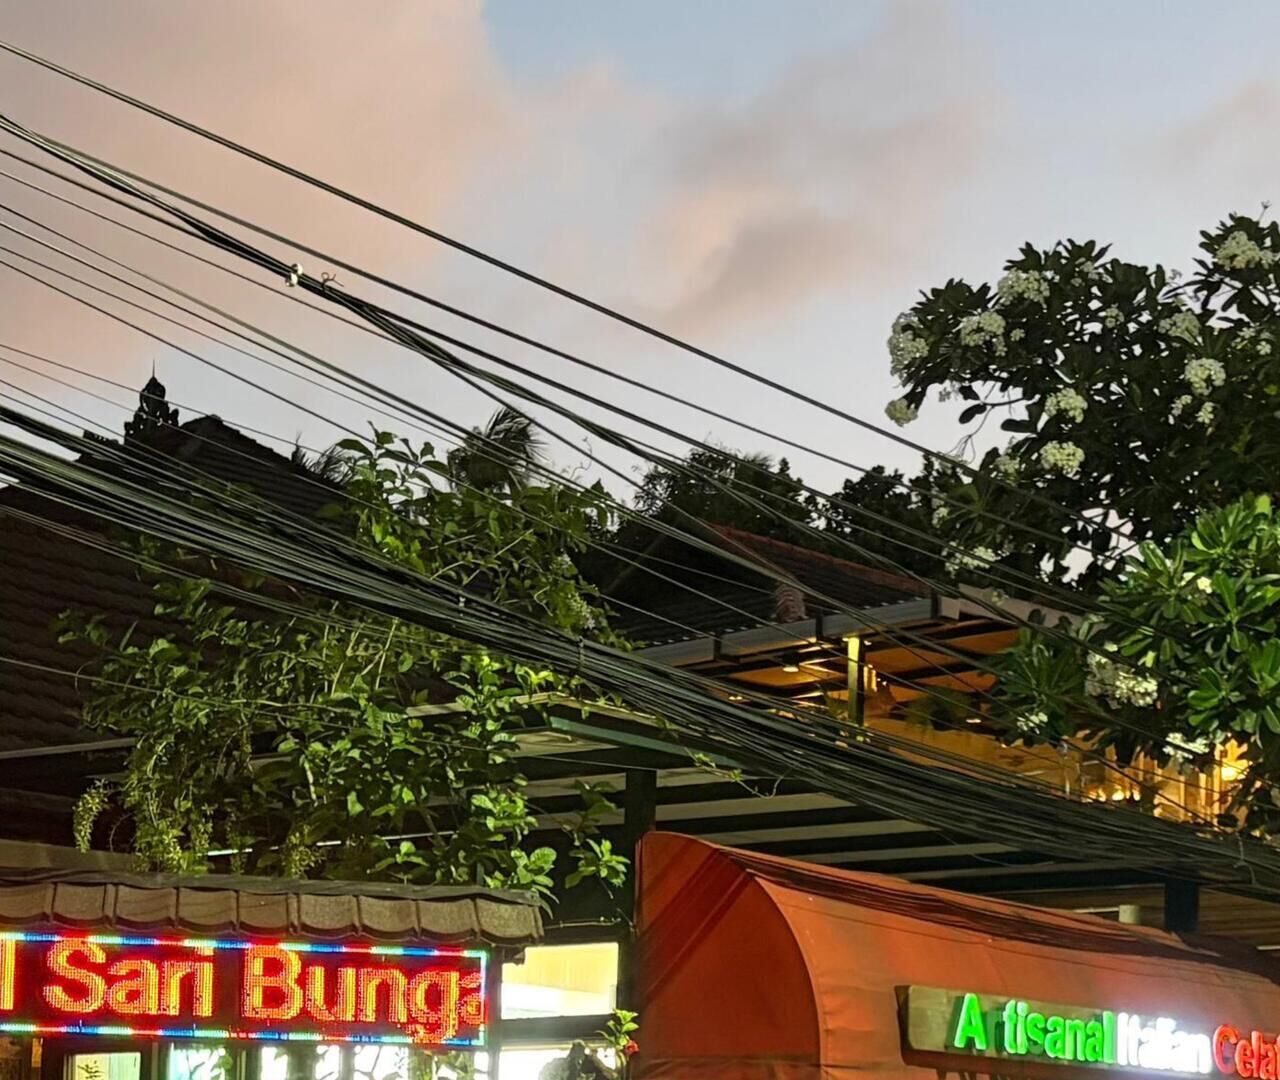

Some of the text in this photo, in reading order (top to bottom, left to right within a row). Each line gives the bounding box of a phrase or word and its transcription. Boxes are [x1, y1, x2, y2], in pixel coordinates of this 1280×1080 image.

[42, 938, 214, 1018] Sari
[953, 992, 1115, 1065] Artisanal
[1117, 1011, 1213, 1074] Italian
